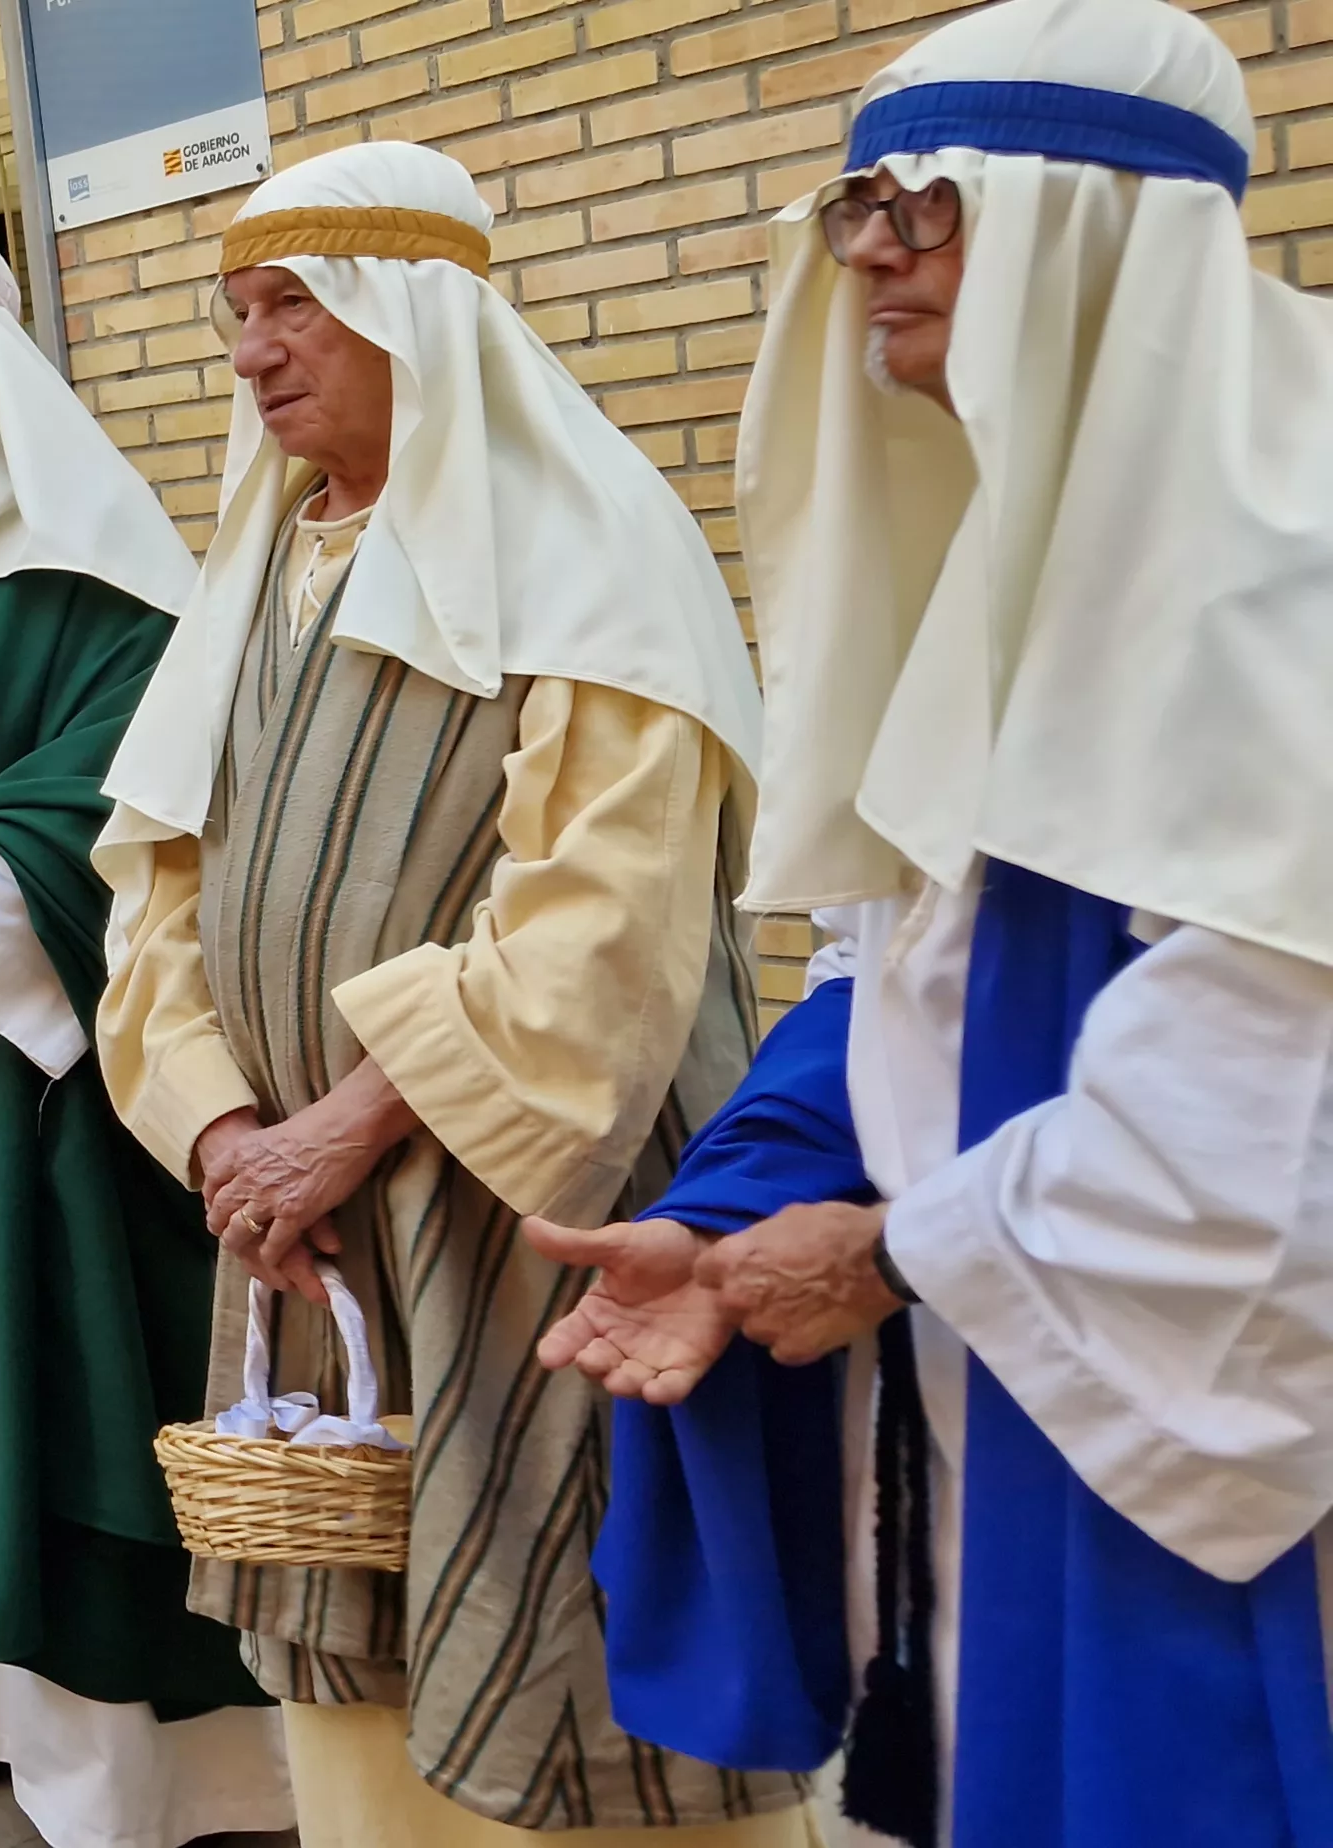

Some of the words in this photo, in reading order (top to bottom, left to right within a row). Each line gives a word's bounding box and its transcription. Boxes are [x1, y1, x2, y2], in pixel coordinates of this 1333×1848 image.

[183, 132, 240, 157] GOBIERNO
[184, 158, 199, 172] DE
[202, 144, 250, 168] ARAGON
